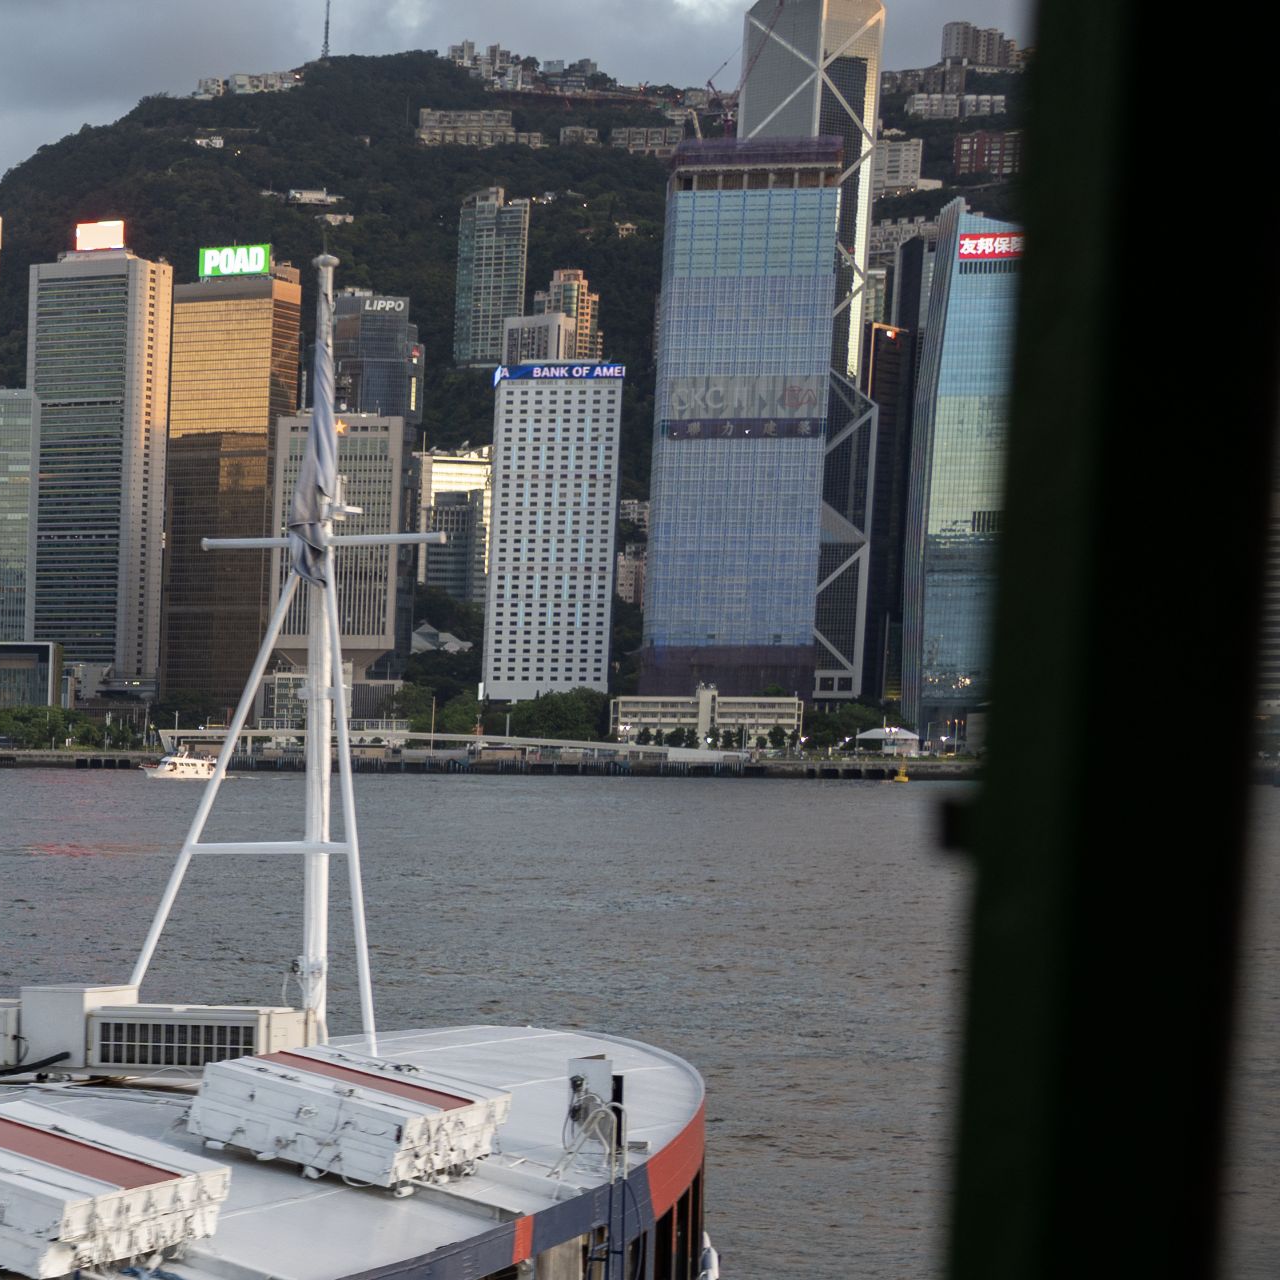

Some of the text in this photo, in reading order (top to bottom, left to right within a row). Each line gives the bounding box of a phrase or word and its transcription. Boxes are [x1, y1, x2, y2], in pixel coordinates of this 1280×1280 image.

[204, 246, 264, 275] POAD
[364, 299, 404, 311] LIPPO
[532, 366, 569, 378] BANK
[572, 366, 590, 378] OF
